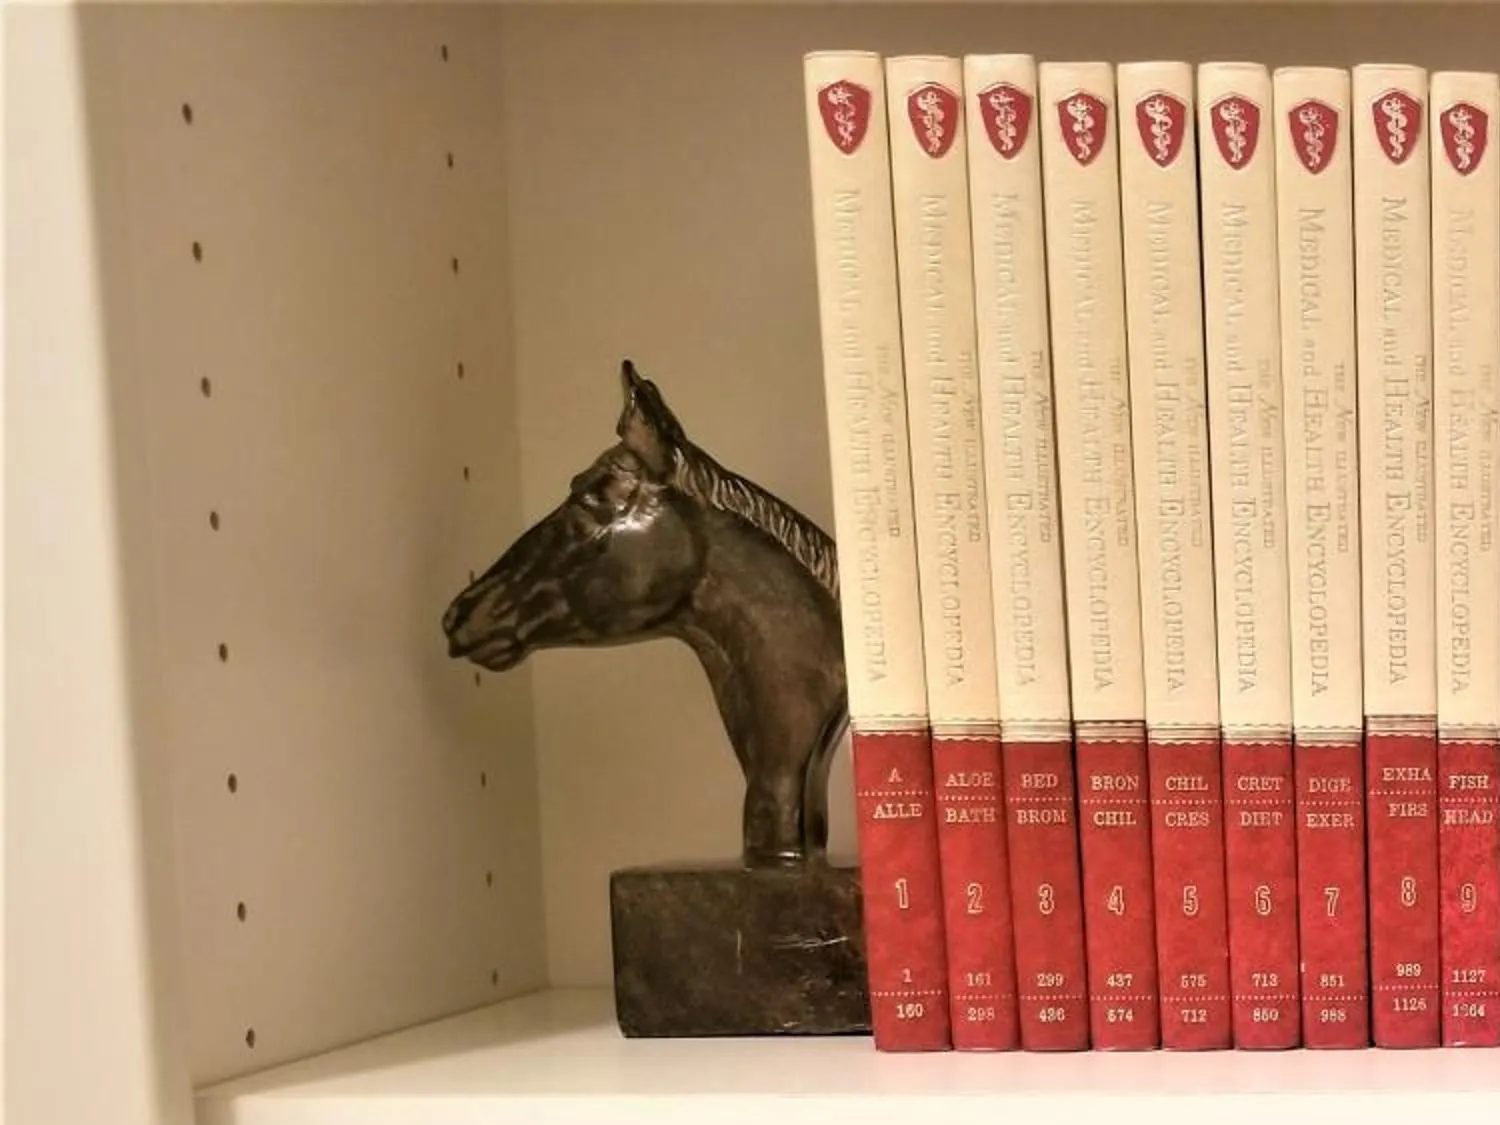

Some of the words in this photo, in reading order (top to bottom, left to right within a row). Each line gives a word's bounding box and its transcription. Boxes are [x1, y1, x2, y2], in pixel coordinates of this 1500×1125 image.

[1381, 197, 1409, 321] MEDICAL
[1298, 208, 1325, 331] MEDICAL
[1384, 373, 1409, 481] HEALTH
[1303, 387, 1329, 494] HEALTH
[1385, 492, 1412, 686] ENCYCLOPEDIA
[1306, 502, 1331, 697] ENCYCLOPEDIA
[1449, 501, 1475, 695] ENCYCLOPEDIA
[888, 768, 902, 783] A
[945, 772, 995, 787] ALOE
[1020, 773, 1058, 788] BED
[1382, 767, 1432, 781] EXHA
[1090, 775, 1139, 791] BRON
[1165, 776, 1209, 791] CHIL
[1237, 775, 1284, 791] CRET
[1449, 775, 1489, 790] FISH
[873, 803, 922, 819] ALLE
[945, 807, 996, 823] BATH
[1016, 809, 1068, 824] BROM
[1093, 811, 1137, 826] CHIL
[1239, 811, 1283, 827] DIET
[1443, 809, 1493, 824] HEAD
[1165, 812, 1210, 827] CRES
[1306, 813, 1355, 828] EXER
[895, 877, 909, 909] 1
[967, 882, 984, 914] 2
[1038, 883, 1054, 915] 3
[1401, 876, 1417, 907] 8
[1460, 883, 1476, 913] 9
[1107, 884, 1125, 916] 4
[1182, 884, 1199, 916] 5
[1254, 884, 1271, 916] 6
[1324, 887, 1340, 917] 7
[1396, 963, 1422, 977] 989
[1452, 969, 1486, 983] 1127
[1106, 973, 1133, 988] 437
[1252, 972, 1278, 987] 713
[1181, 1009, 1207, 1023] 712
